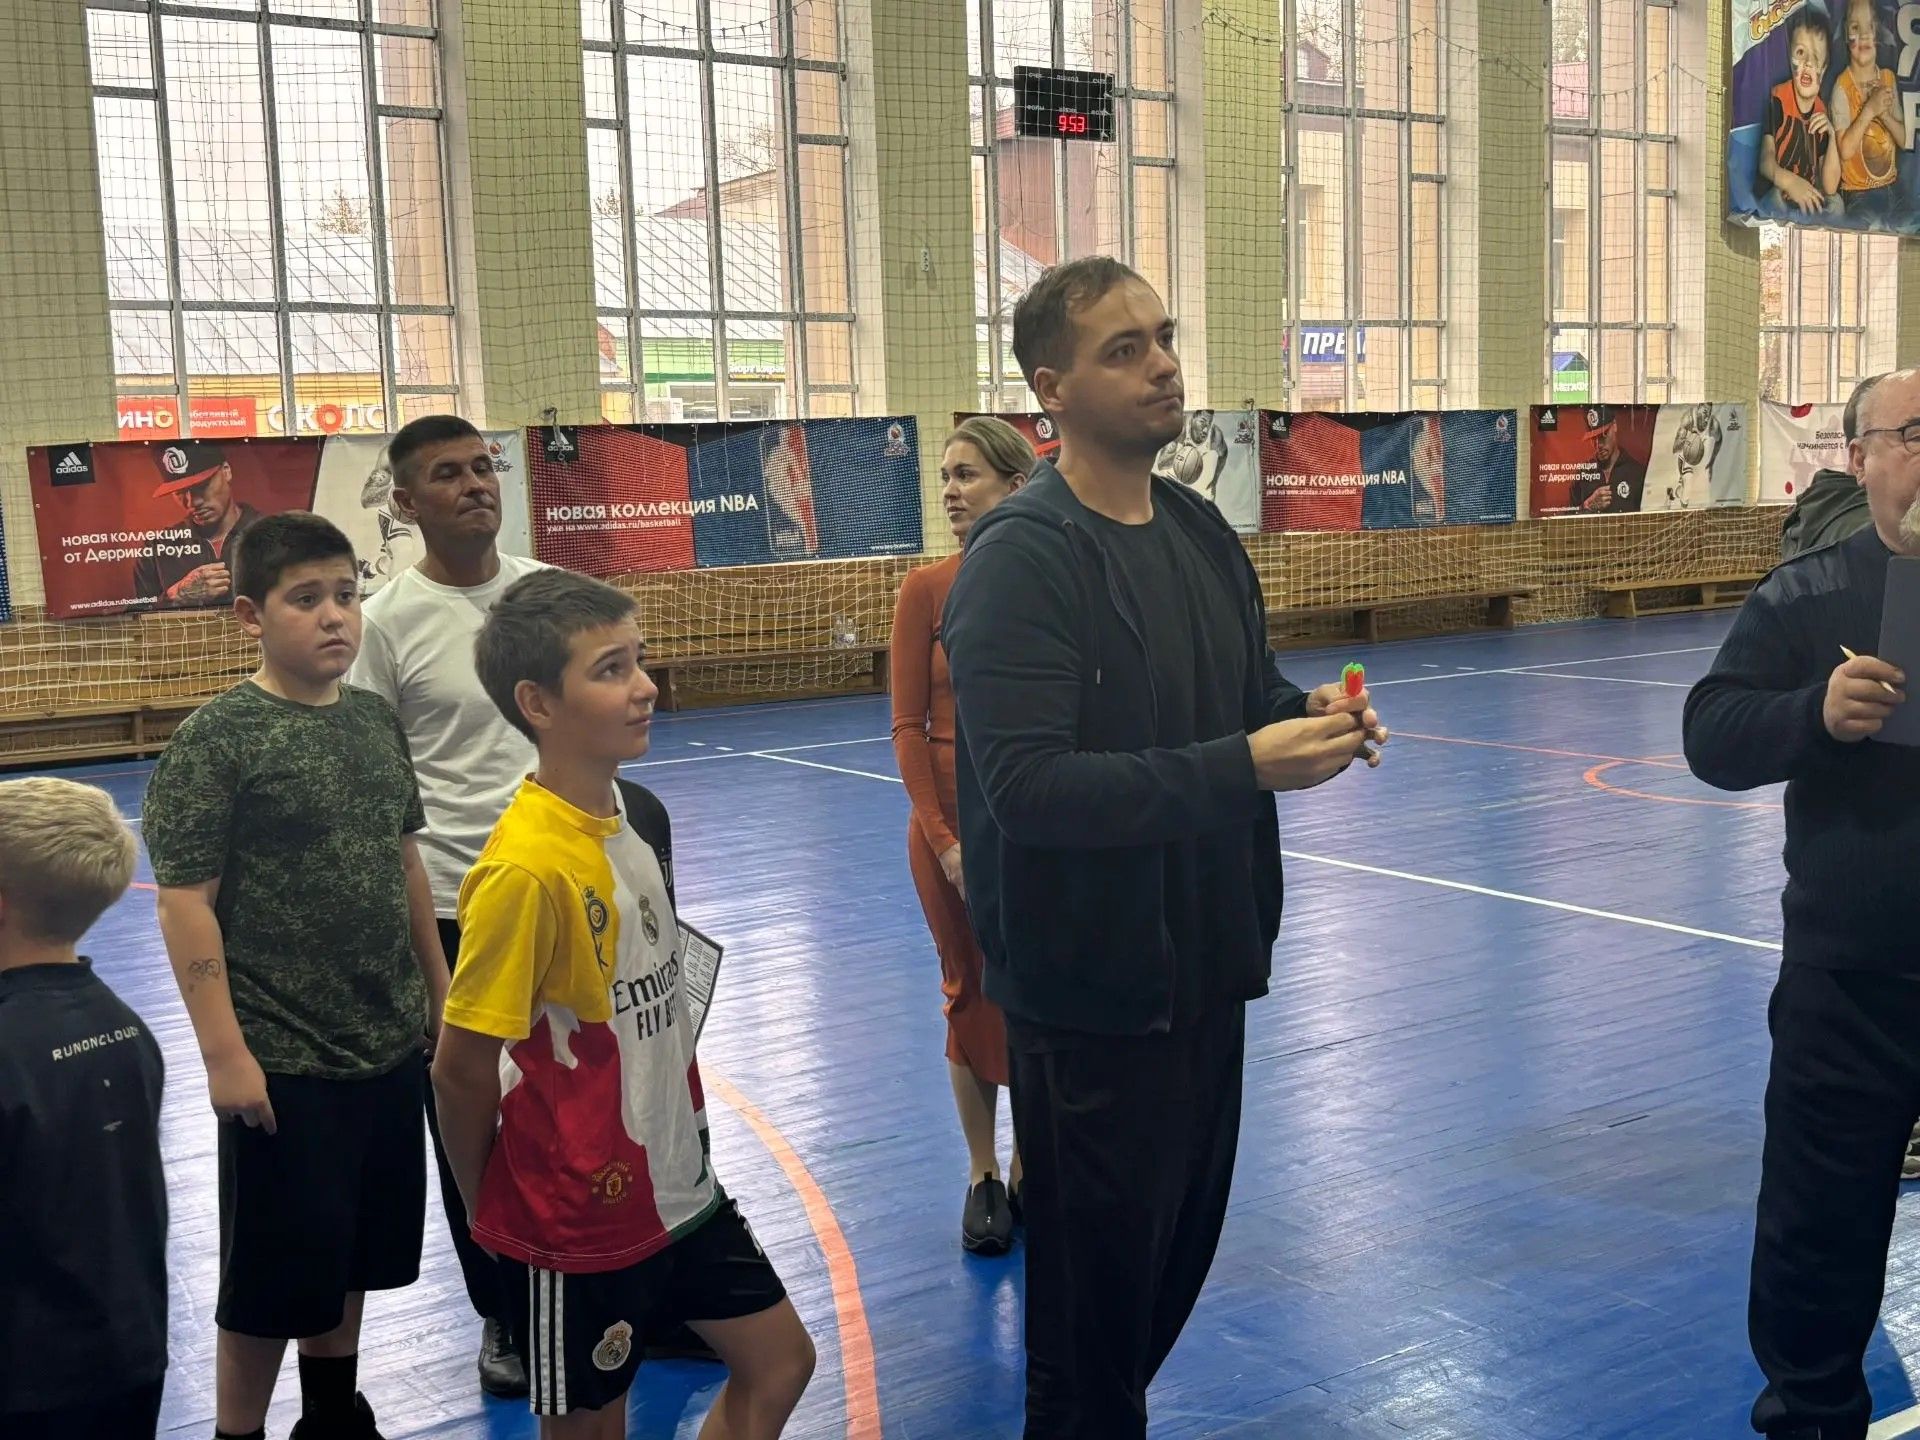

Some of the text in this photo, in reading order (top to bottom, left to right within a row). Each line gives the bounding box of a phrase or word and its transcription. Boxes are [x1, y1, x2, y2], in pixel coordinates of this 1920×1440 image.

[55, 465, 89, 474] adidas
[1266, 470, 1406, 488] новая коллекция NBA
[546, 494, 759, 521] новая коллекция NBA
[62, 527, 192, 547] новая коллекция
[64, 543, 202, 564] от Деррика Роуза
[636, 1003, 660, 1041] FLY
